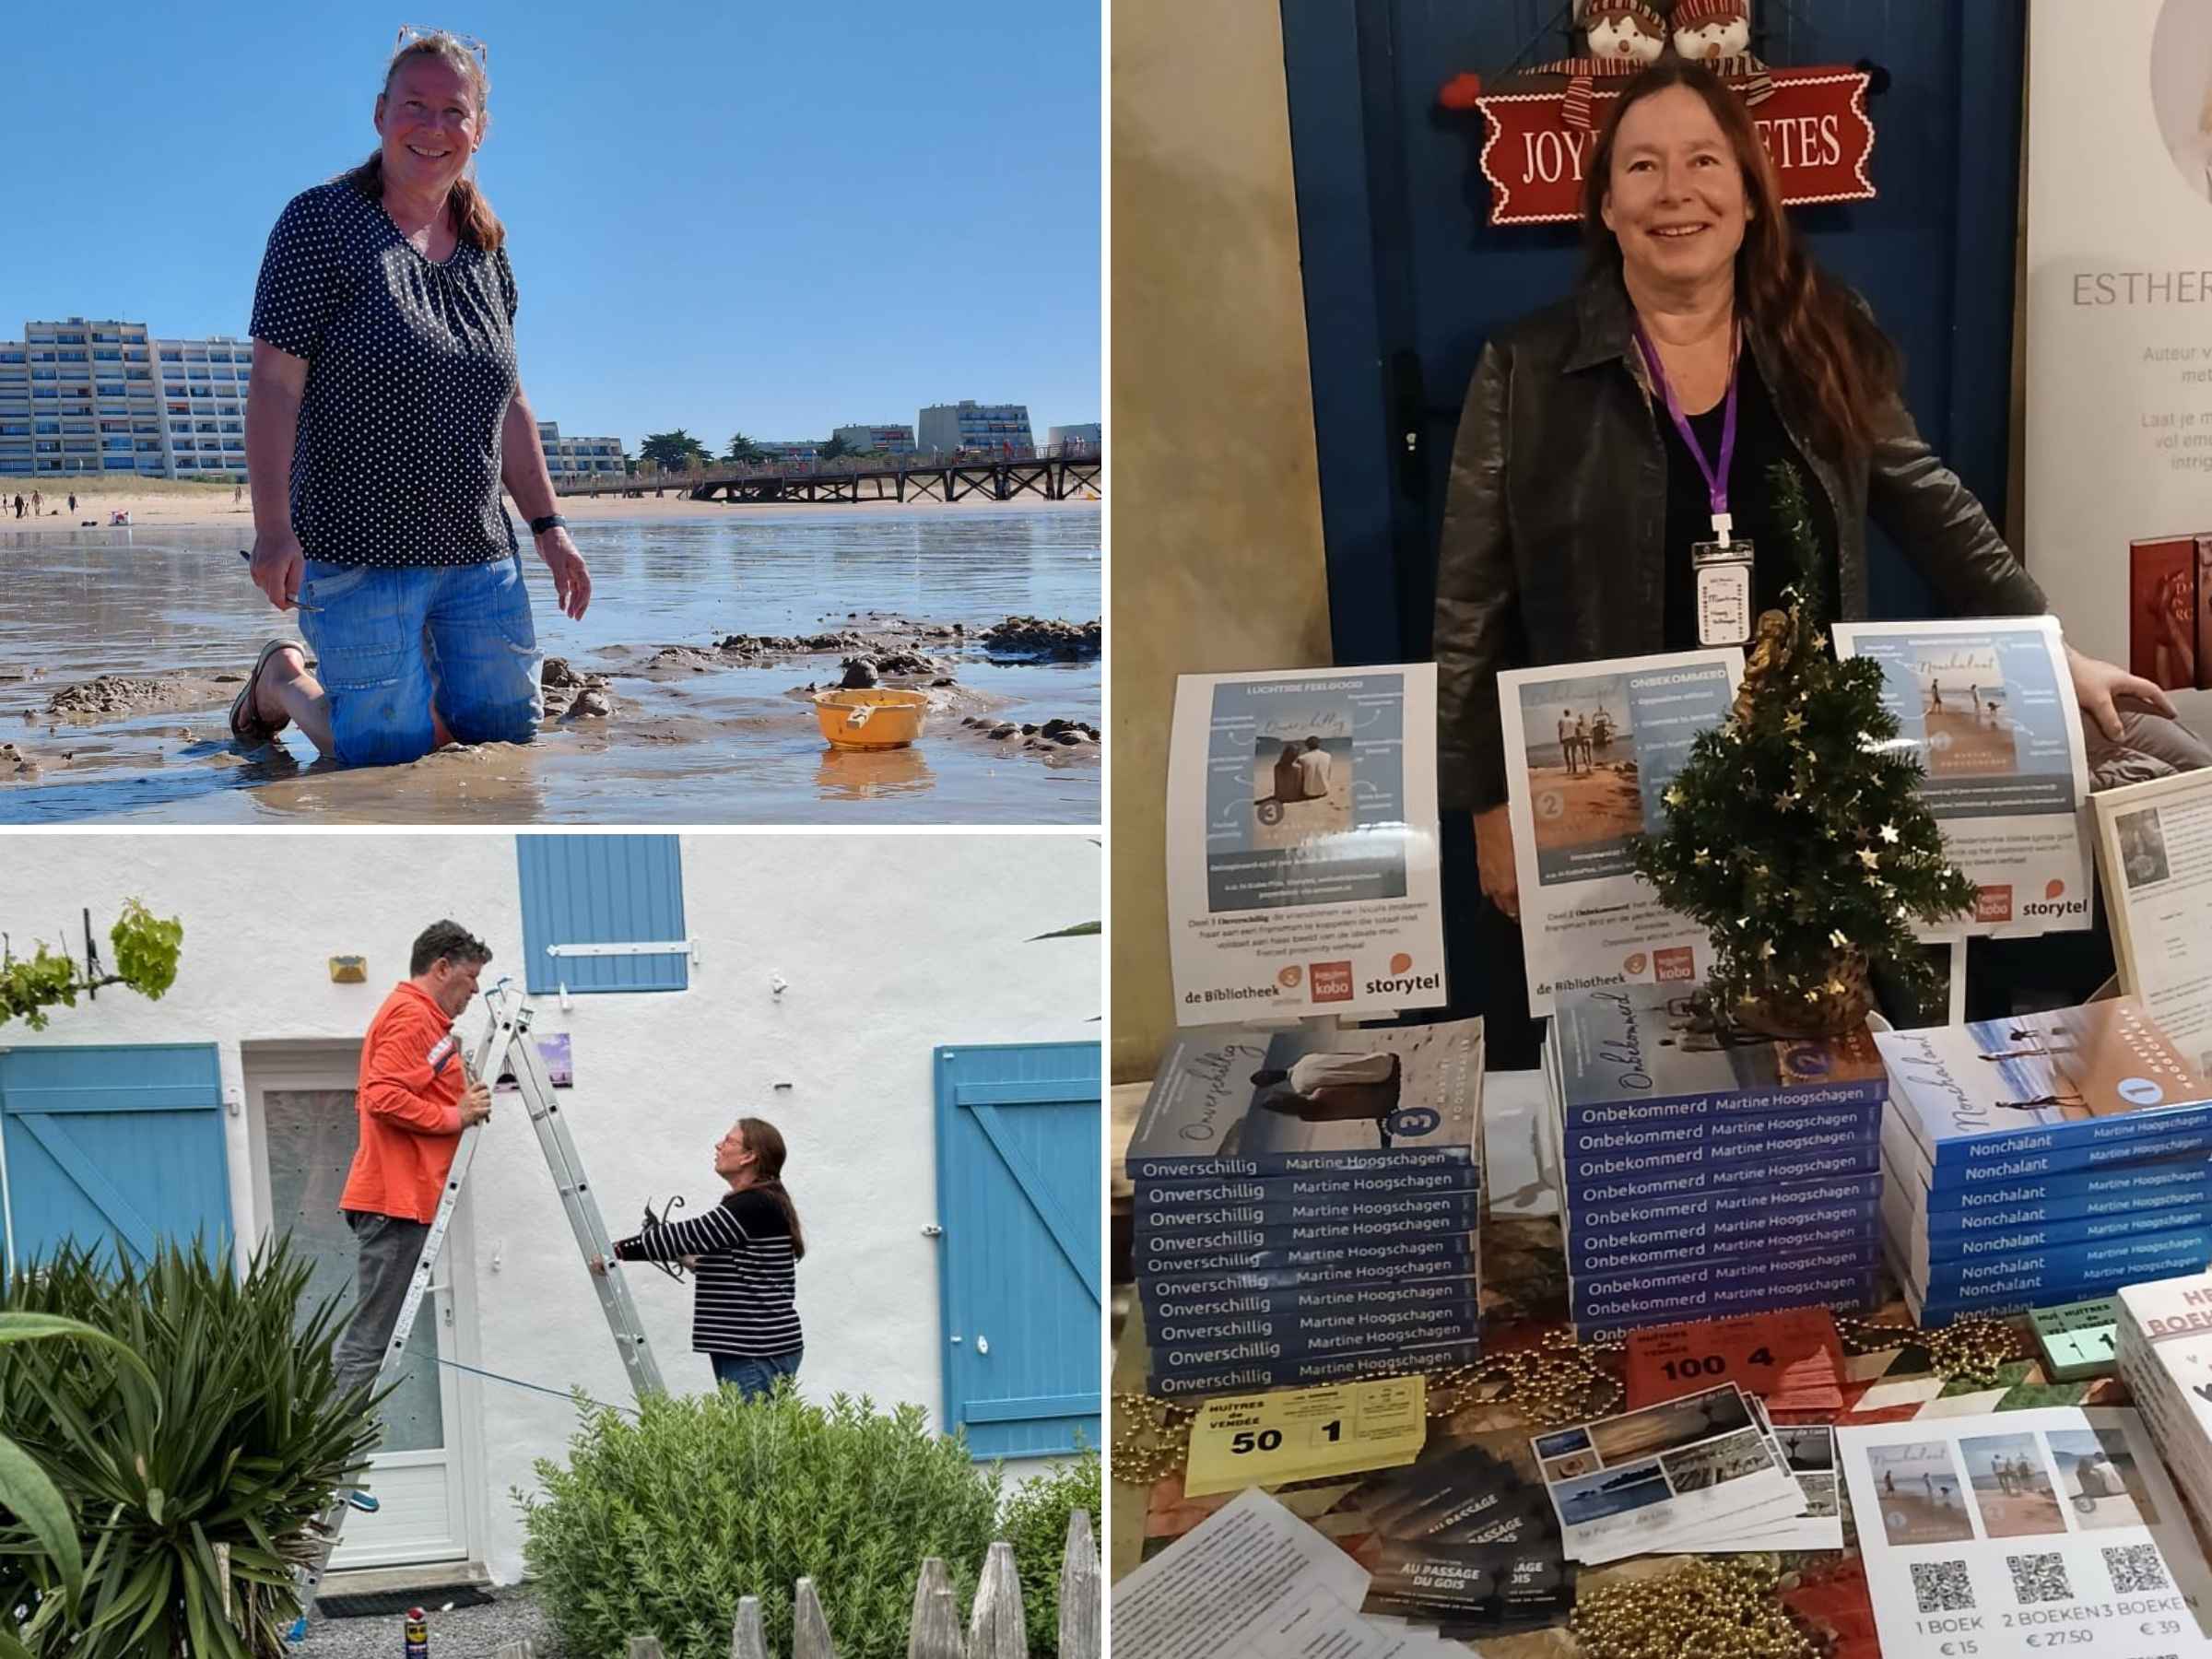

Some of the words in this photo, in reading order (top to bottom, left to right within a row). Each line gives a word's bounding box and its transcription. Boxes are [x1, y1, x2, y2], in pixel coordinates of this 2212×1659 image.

[1523, 130, 1601, 184] JOY
[2143, 347, 2197, 361] Auteur
[2141, 413, 2176, 428] Laat
[2180, 413, 2195, 429] je
[2155, 434, 2178, 449] vol
[1542, 795, 1559, 816] 2
[2023, 899, 2088, 917] storytel
[1366, 973, 1441, 995] storytel
[1536, 984, 1552, 995] de
[1555, 973, 1626, 991] Bibliotheek
[1659, 967, 1690, 980] kobo
[1185, 993, 1202, 1005] de
[1205, 984, 1280, 1003] Bibliotheek
[1315, 982, 1349, 996] kobo
[1583, 1100, 1707, 1124] Onbekommerd
[1715, 1095, 1770, 1112] Martine
[1772, 1087, 1864, 1109] Hoogschagen
[1580, 1124, 1704, 1150] Onbekommerd
[1711, 1120, 1766, 1136] Martine
[1767, 1112, 1858, 1134] Hoogschagen
[1970, 1135, 2053, 1158] Nonchalant
[2094, 1124, 2136, 1139] Martine
[2137, 1114, 2208, 1134] Hoogschagen
[1143, 1159, 1257, 1178] Onverschillig
[1287, 1157, 1342, 1171] Martine
[1346, 1152, 1445, 1169] Hoogschagen
[1580, 1150, 1703, 1177] Onbekommerd
[1711, 1142, 1763, 1159] Martine
[1766, 1129, 1855, 1152] Hoogschagen
[1965, 1158, 2049, 1181] Nonchalant
[2089, 1148, 2132, 1162] Martine
[2133, 1136, 2204, 1156] Hoogschagen
[1149, 1185, 1265, 1203] Onverschillig
[1293, 1180, 1350, 1194] Martine
[1354, 1173, 1453, 1192] Hoogschagen
[1583, 1174, 1706, 1202] Onbekommerd
[1713, 1169, 1766, 1183] Martine
[1768, 1156, 1857, 1178] Hoogschagen
[1961, 1186, 2046, 1207] Nonchalant
[2088, 1178, 2130, 1192] Martine
[2133, 1170, 2206, 1187] Hoogschagen
[1149, 1207, 1265, 1227] Onverschillig
[1292, 1204, 1349, 1218] Martine
[1352, 1198, 1451, 1216] Hoogschagen
[1585, 1200, 1708, 1227] Onbekommerd
[1715, 1195, 1768, 1211] Martine
[1771, 1183, 1860, 1206] Hoogschagen
[1961, 1208, 2046, 1230] Nonchalant
[2088, 1199, 2130, 1214] Martine
[2132, 1191, 2205, 1208] Hoogschagen
[1149, 1230, 1265, 1252] Onverschillig
[1292, 1225, 1349, 1240] Martine
[1352, 1217, 1451, 1237] Hoogschagen
[1584, 1223, 1706, 1251] Onbekommerd
[1713, 1218, 1767, 1234] Martine
[1769, 1206, 1857, 1228] Hoogschagen
[1962, 1232, 2046, 1254] Nonchalant
[2087, 1221, 2129, 1236] Martine
[2132, 1211, 2203, 1230] Hoogschagen
[1147, 1253, 1261, 1272] Onverschillig
[1288, 1248, 1345, 1263] Martine
[1347, 1241, 1444, 1259] Hoogschagen
[1584, 1243, 1706, 1270] Onbekommerd
[1712, 1237, 1766, 1253] Martine
[1767, 1226, 1856, 1248] Hoogschagen
[1962, 1256, 2045, 1280] Nonchalant
[2087, 1246, 2128, 1261] Martine
[2131, 1235, 2203, 1255] Hoogschagen
[1156, 1277, 1269, 1297] Onverschillig
[1296, 1269, 1353, 1284] Martine
[1356, 1259, 1453, 1277] Hoogschagen
[1589, 1268, 1708, 1296] Onbekommerd
[1715, 1264, 1768, 1279] Martine
[1770, 1252, 1857, 1272] Hoogschagen
[1959, 1276, 2042, 1299] Nonchalant
[2084, 1265, 2124, 1280] Martine
[2127, 1255, 2199, 1275] Hoogschagen
[1159, 1297, 1271, 1318] Onverschillig
[1298, 1292, 1355, 1307] Martine
[1358, 1284, 1453, 1302] Hoogschagen
[1587, 1291, 1707, 1317] Onbekommerd
[1713, 1286, 1766, 1301] Martine
[1768, 1276, 1856, 1299] Hoogschagen
[1160, 1321, 1273, 1341] Onverschillig
[1300, 1315, 1356, 1330] Martine
[1359, 1306, 1453, 1326] Hoogschagen
[1169, 1342, 1280, 1366] Onverschillig
[1307, 1335, 1364, 1350] Martine
[1366, 1324, 1461, 1345] Hoogschagen
[1747, 1347, 1775, 1366] 4
[1160, 1369, 1273, 1394] Onverschillig
[1299, 1363, 1356, 1378] Martine
[1358, 1351, 1453, 1372] Hoogschagen
[1660, 1356, 1725, 1380] 100
[1230, 1430, 1282, 1454] 50
[1322, 1420, 1342, 1441] 1
[1401, 1563, 1420, 1574] AU
[1422, 1564, 1480, 1580] PASSAGE
[1413, 1576, 1432, 1586] DU
[1433, 1578, 1466, 1590] GOIS
[1914, 1620, 1924, 1634] 1
[1928, 1617, 1984, 1635] BOEK
[2002, 1614, 2014, 1628] 2
[2018, 1604, 2100, 1626] BOEKEN
[2103, 1605, 2113, 1618] 3
[2026, 1634, 2042, 1648] €
[2046, 1629, 2094, 1647] 27.50
[2139, 1623, 2155, 1636] €
[2159, 1619, 2181, 1634] 39
[1940, 1641, 1955, 1656] €
[1959, 1641, 1979, 1654] 15
